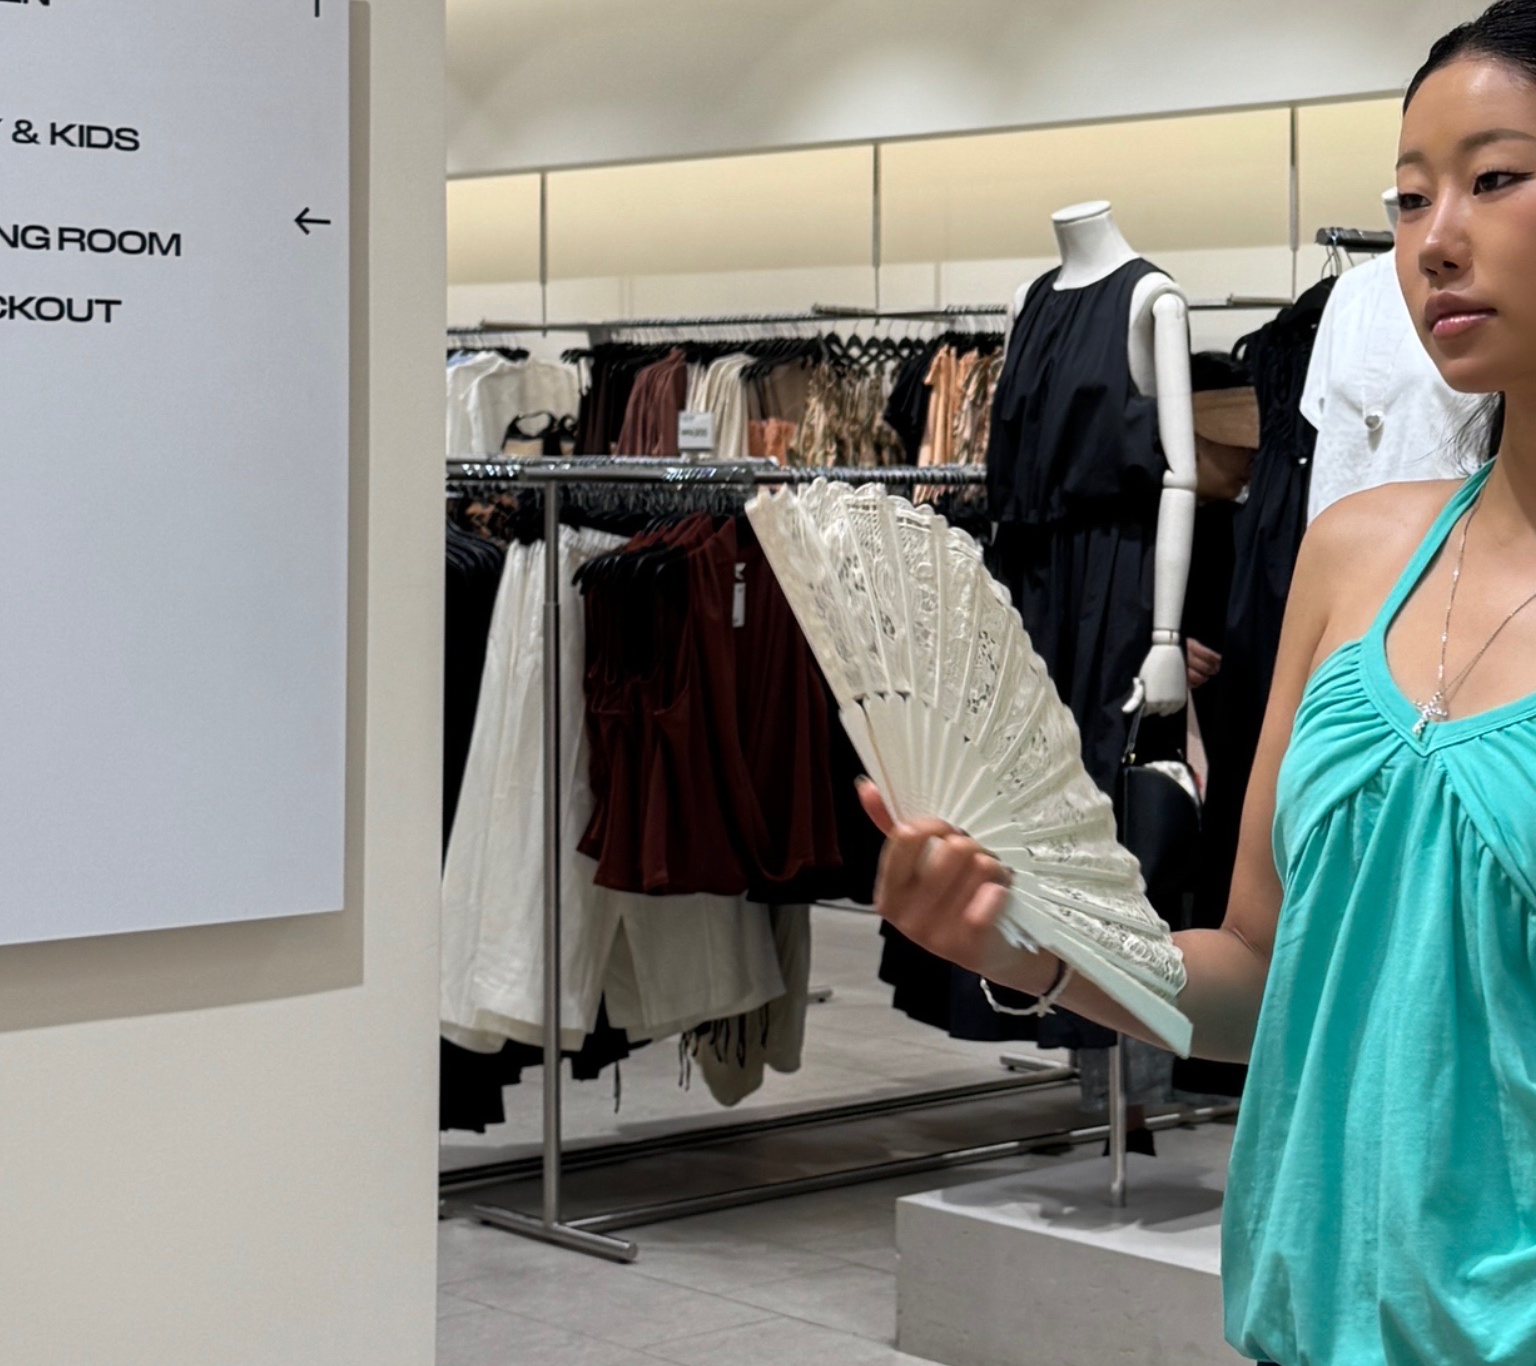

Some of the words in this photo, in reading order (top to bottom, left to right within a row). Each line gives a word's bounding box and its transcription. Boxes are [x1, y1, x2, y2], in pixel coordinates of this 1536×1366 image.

[12, 119, 41, 145] &
[50, 122, 140, 152] KIDS
[58, 226, 182, 257] ROOM
[0, 295, 122, 323] KOUT
